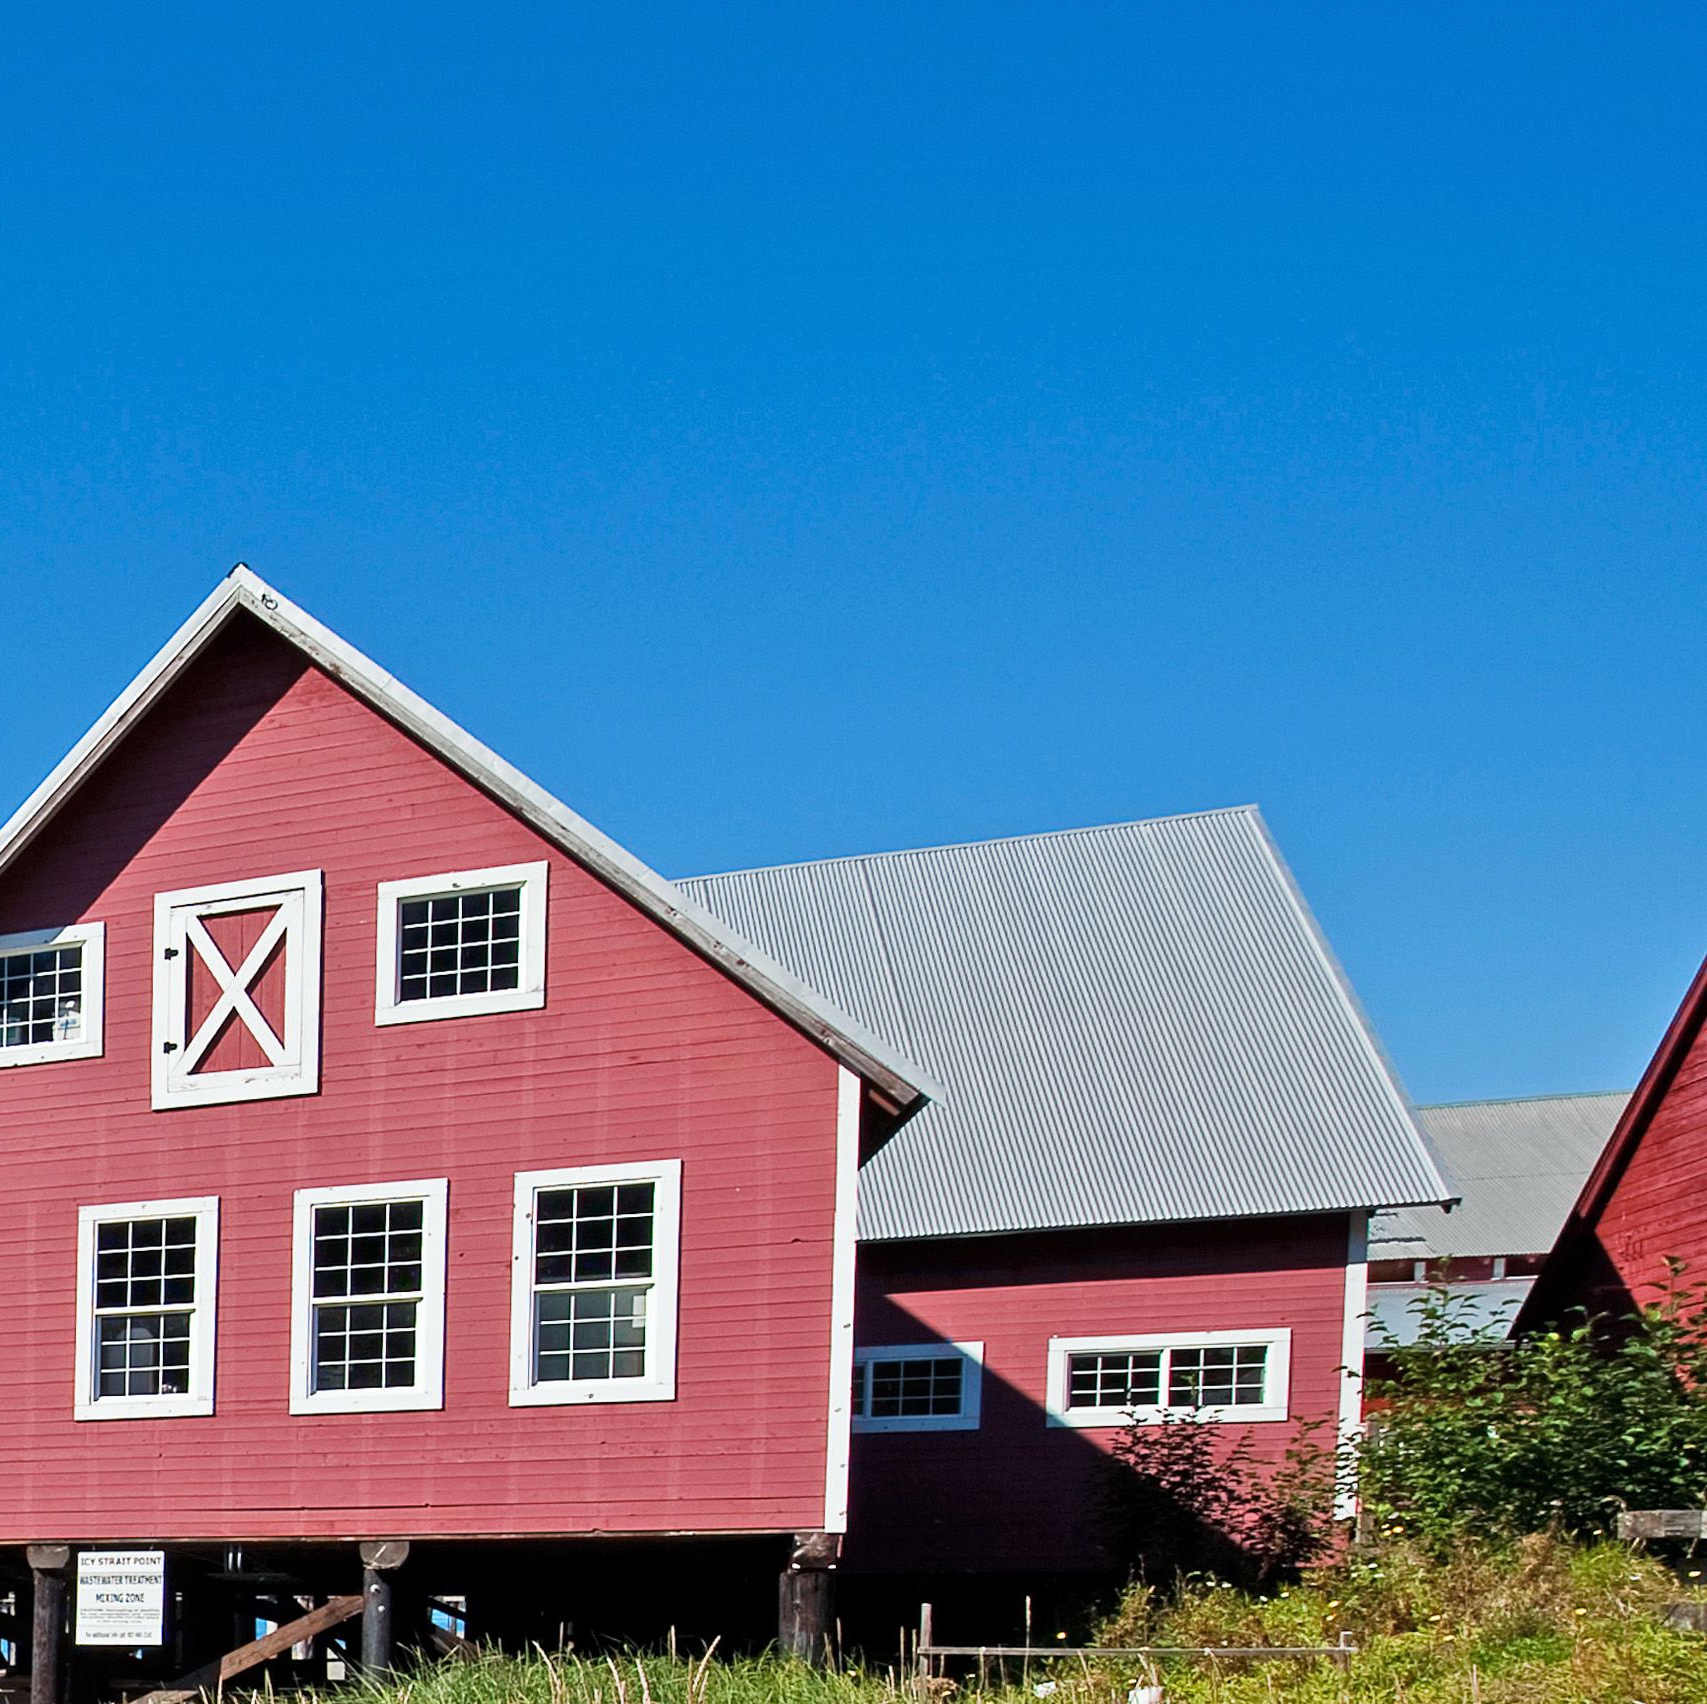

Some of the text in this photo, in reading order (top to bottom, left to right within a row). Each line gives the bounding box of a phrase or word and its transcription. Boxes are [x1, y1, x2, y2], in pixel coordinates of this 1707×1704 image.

[81, 1557, 162, 1566] ICY STRAIT POINT
[80, 1575, 163, 1585] WASTEWATER TREATMENT
[96, 1593, 145, 1603] MIXING ZONE
